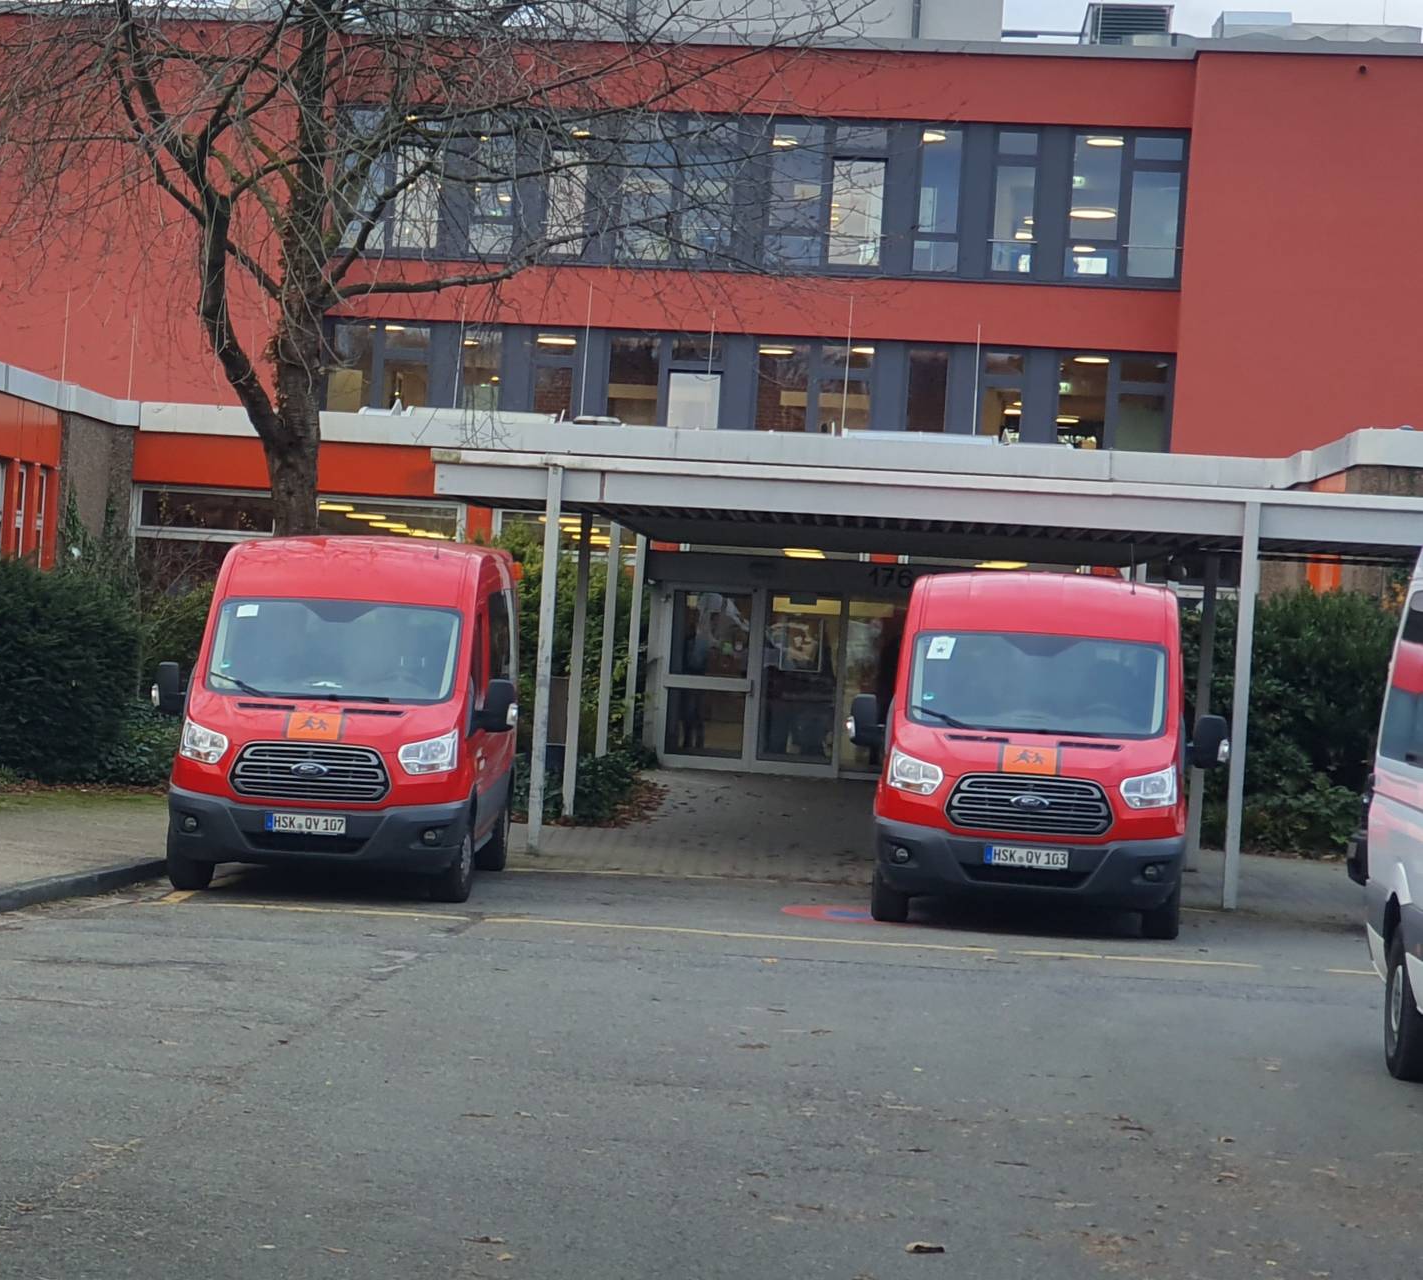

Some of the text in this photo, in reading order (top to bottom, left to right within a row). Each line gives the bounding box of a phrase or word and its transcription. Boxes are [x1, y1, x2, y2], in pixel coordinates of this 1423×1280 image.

[868, 567, 914, 589] 176
[274, 815, 296, 829] HSK
[322, 819, 344, 831] 107
[993, 848, 1017, 863] HSK
[1044, 852, 1067, 866] 103
